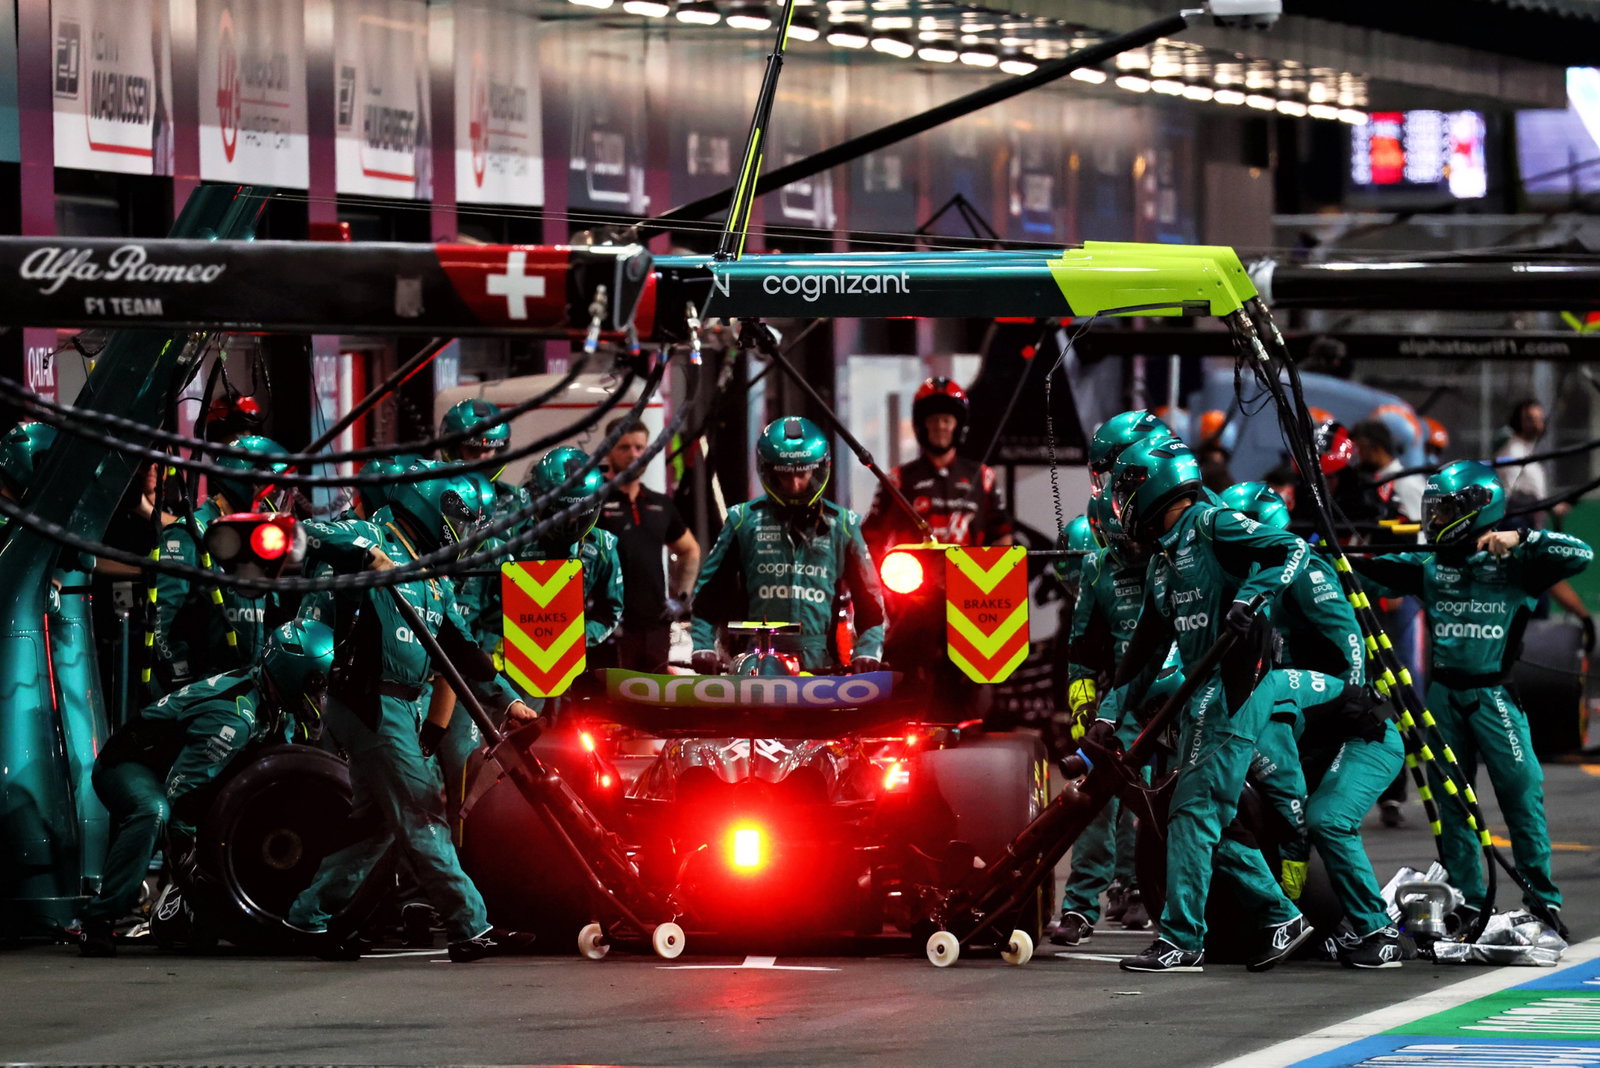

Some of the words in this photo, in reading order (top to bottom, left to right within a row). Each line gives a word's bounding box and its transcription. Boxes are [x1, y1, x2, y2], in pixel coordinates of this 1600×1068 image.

[19, 246, 104, 294] Alfa
[103, 245, 226, 283] Romeo
[763, 270, 910, 302] cognizant
[84, 297, 106, 315] F1
[112, 298, 164, 316] TEAM
[757, 561, 828, 578] cognizant
[1281, 537, 1306, 584] aramco
[759, 585, 826, 603] aramco
[964, 599, 1012, 609] BRAKES
[1436, 599, 1507, 616] cognizant
[519, 612, 568, 624] BRAKES
[978, 613, 998, 623] ON
[533, 627, 554, 637] ON
[1435, 623, 1504, 640] aramco
[619, 677, 880, 704] aramco
[1493, 690, 1513, 728] MARTIN
[1189, 728, 1203, 766] ASTON
[1198, 686, 1216, 728] MARTIN
[1506, 729, 1524, 763] ASTON
